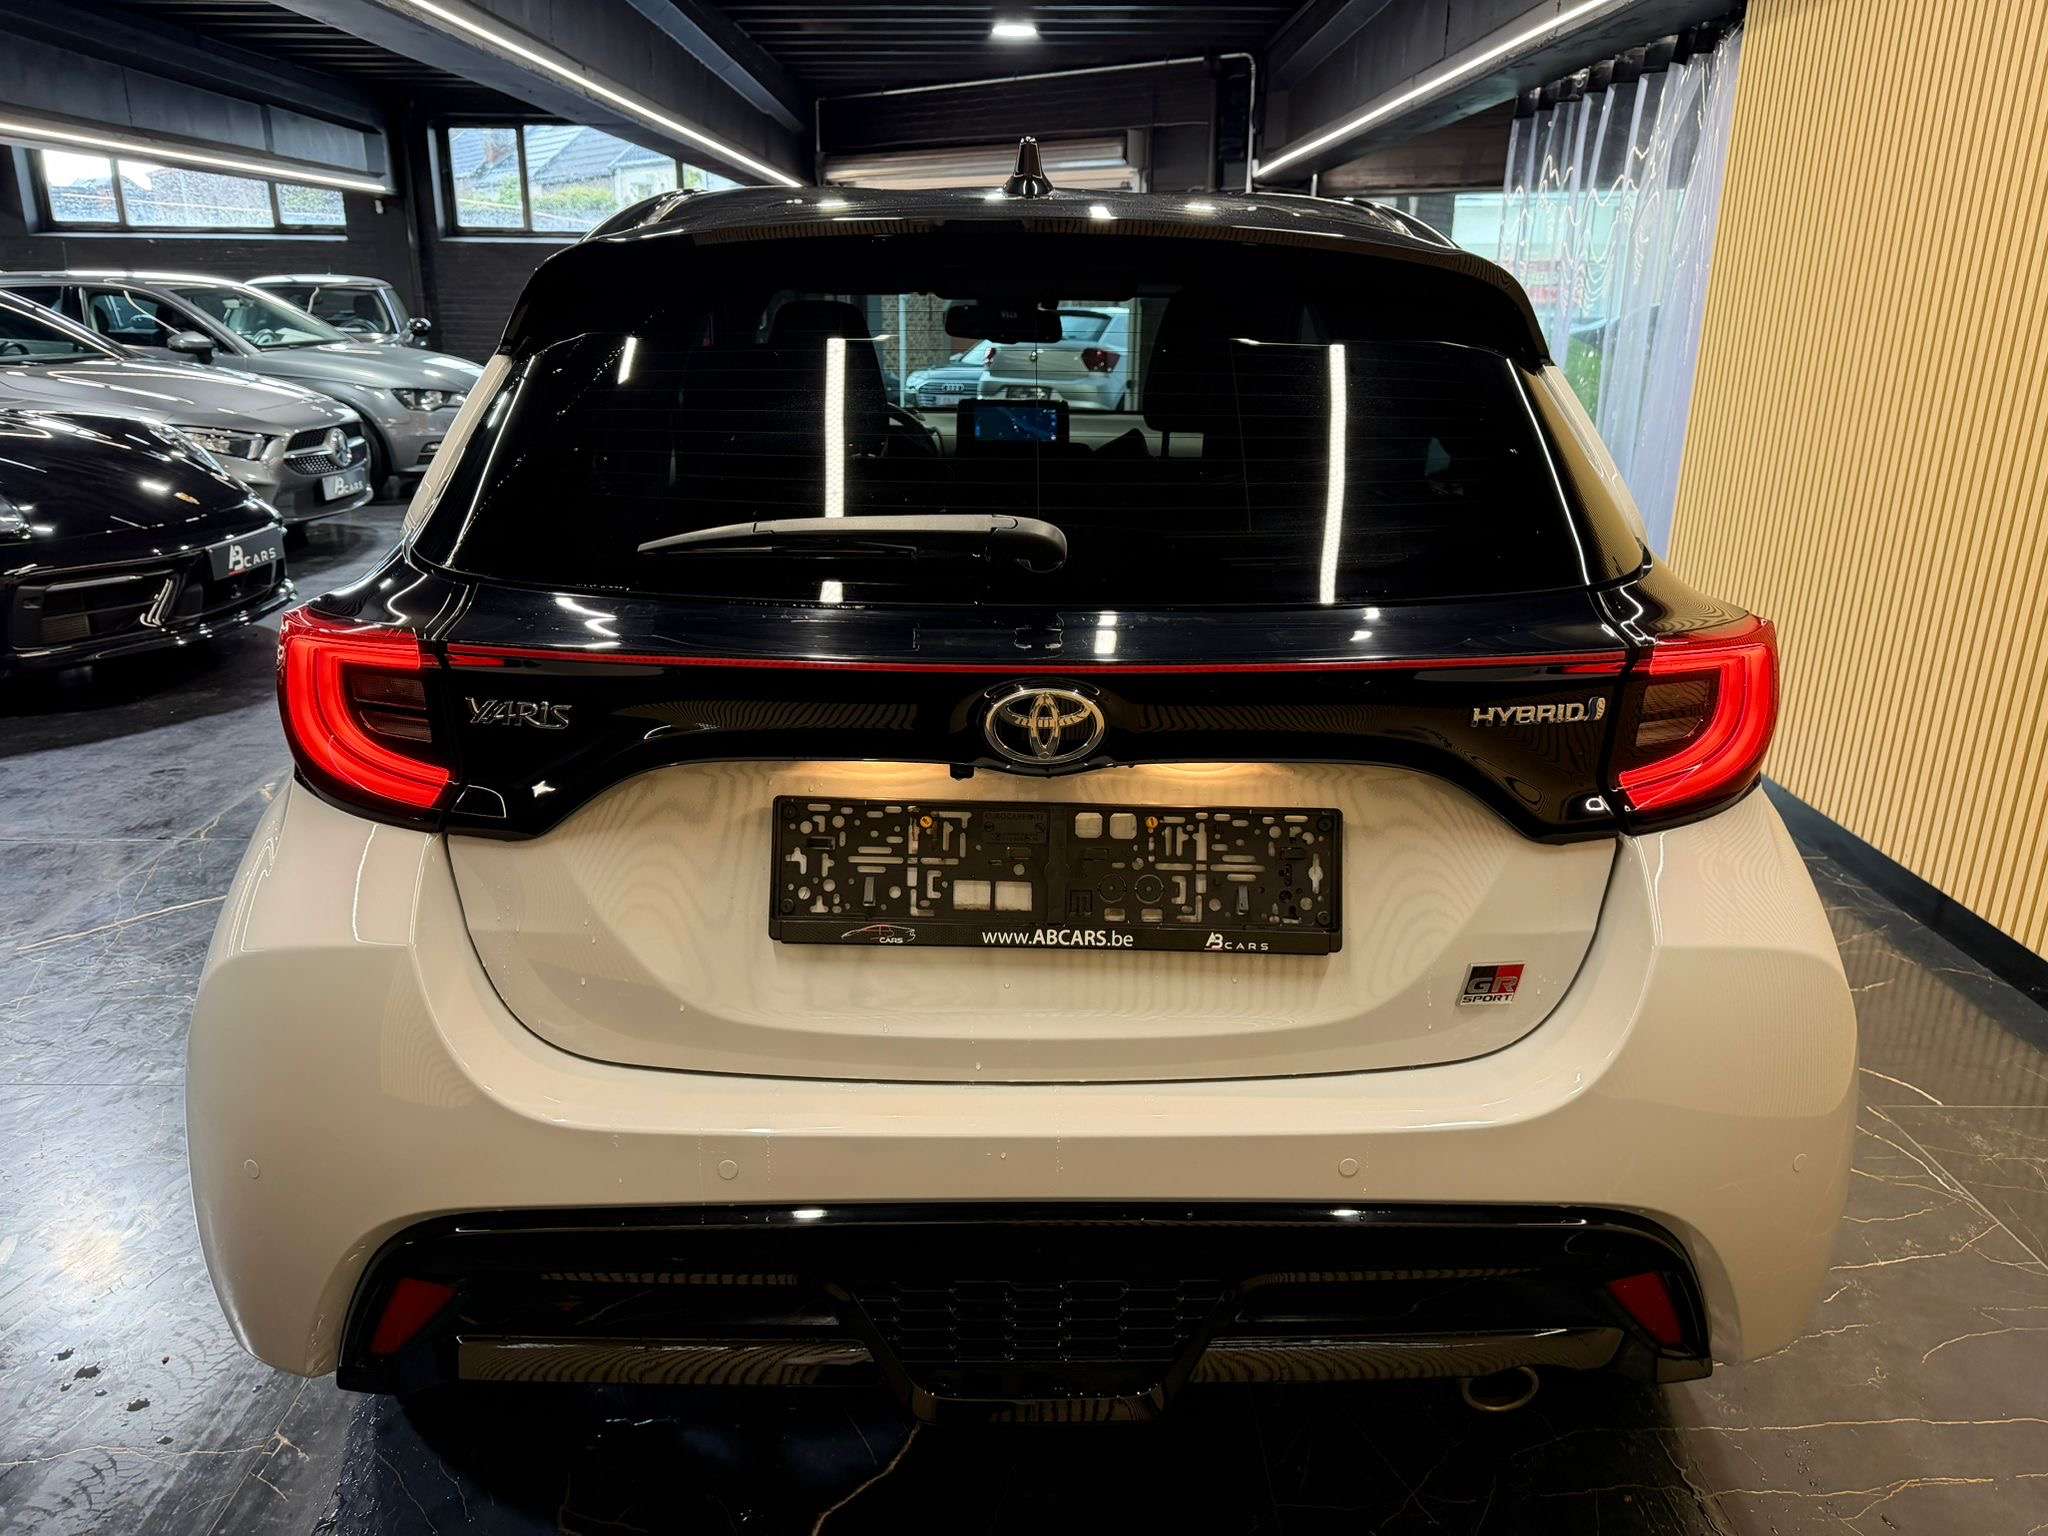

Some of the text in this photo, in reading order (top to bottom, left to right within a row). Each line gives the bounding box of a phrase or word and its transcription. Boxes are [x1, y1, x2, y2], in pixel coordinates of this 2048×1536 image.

[464, 696, 573, 729] YARIS
[1472, 703, 1586, 726] HYBRID
[982, 929, 1134, 947] www.ABCARS.be
[1466, 976, 1518, 993] GR
[1461, 994, 1511, 1003] SPORT
